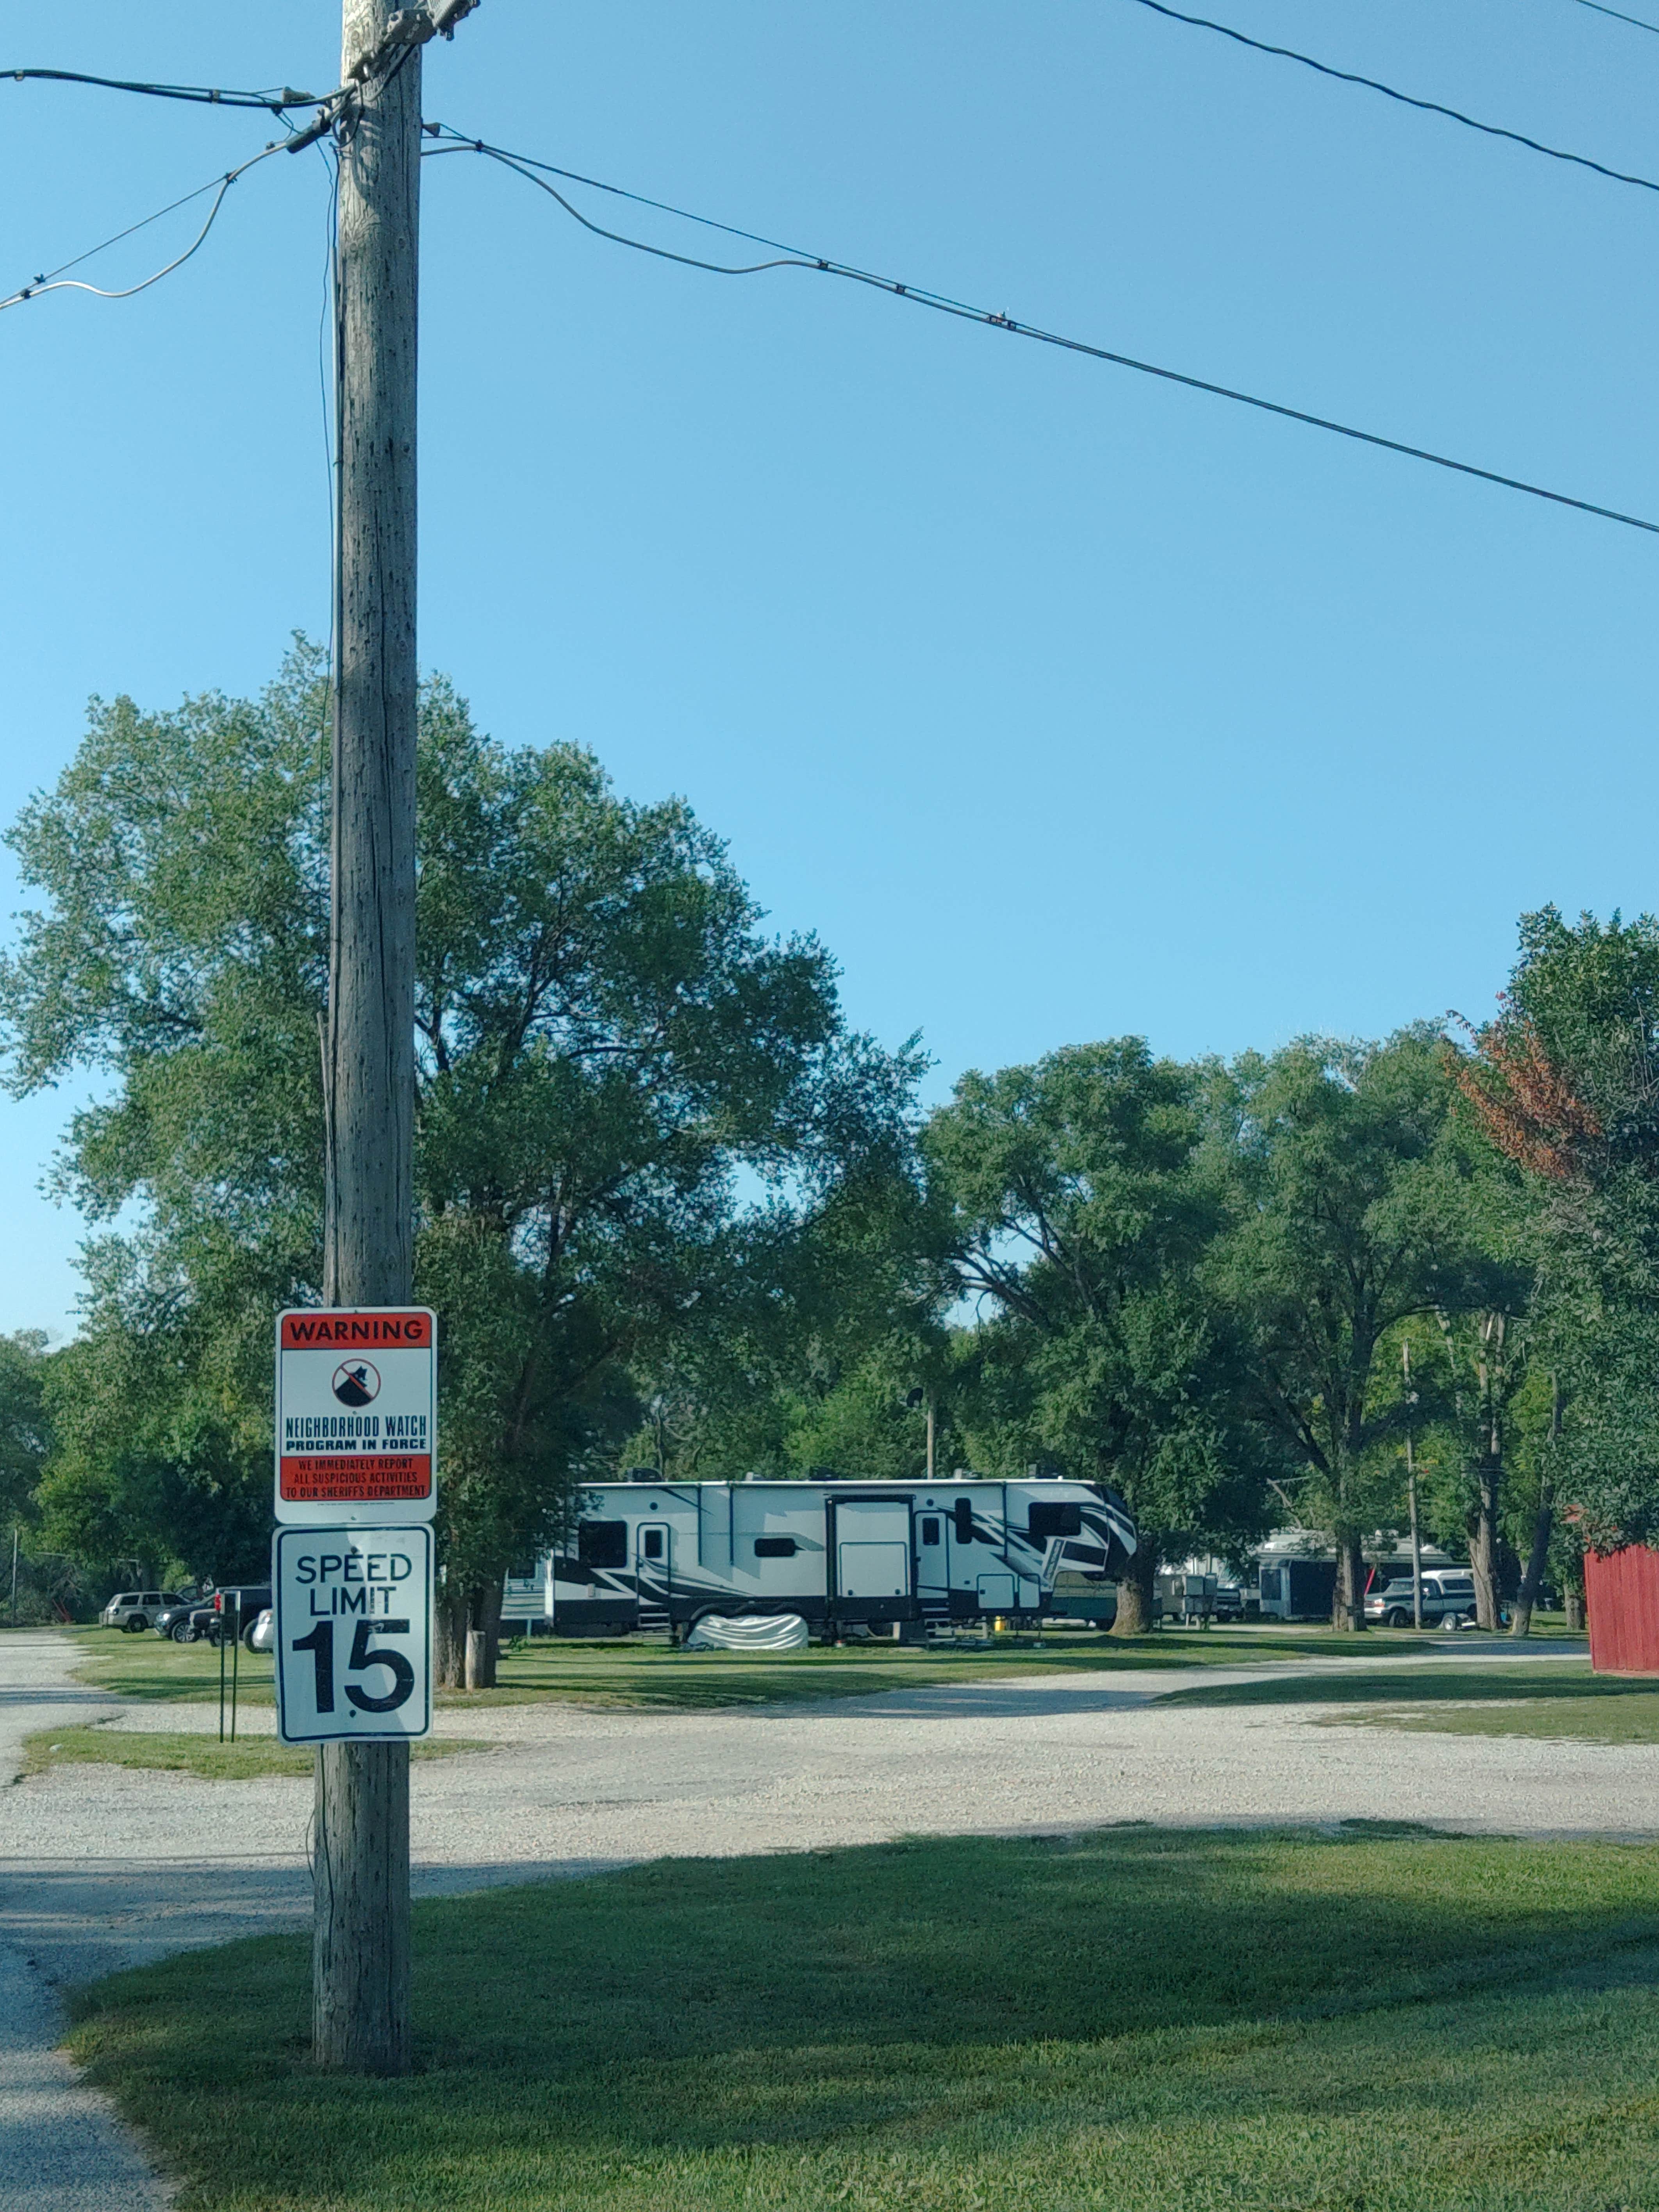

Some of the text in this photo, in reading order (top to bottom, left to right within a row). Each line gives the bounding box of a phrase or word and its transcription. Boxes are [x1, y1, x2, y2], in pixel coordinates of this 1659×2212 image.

[290, 1320, 423, 1341] WARNING
[286, 1415, 426, 1438] NEIGHBORHOOD WATCH
[286, 1439, 426, 1451] PROGRAM IN FORCE
[298, 1458, 413, 1470] WE IMMEDIATELY REPORT
[294, 1472, 417, 1484] ALL SUSPICIOUS ACTIVITIES
[286, 1487, 297, 1497] TO
[300, 1487, 318, 1497] OUR
[367, 1484, 426, 1496] DEPARTMENT
[295, 1553, 412, 1584] SPEED
[310, 1586, 396, 1616] LIMIT
[292, 1619, 415, 1713] 15
